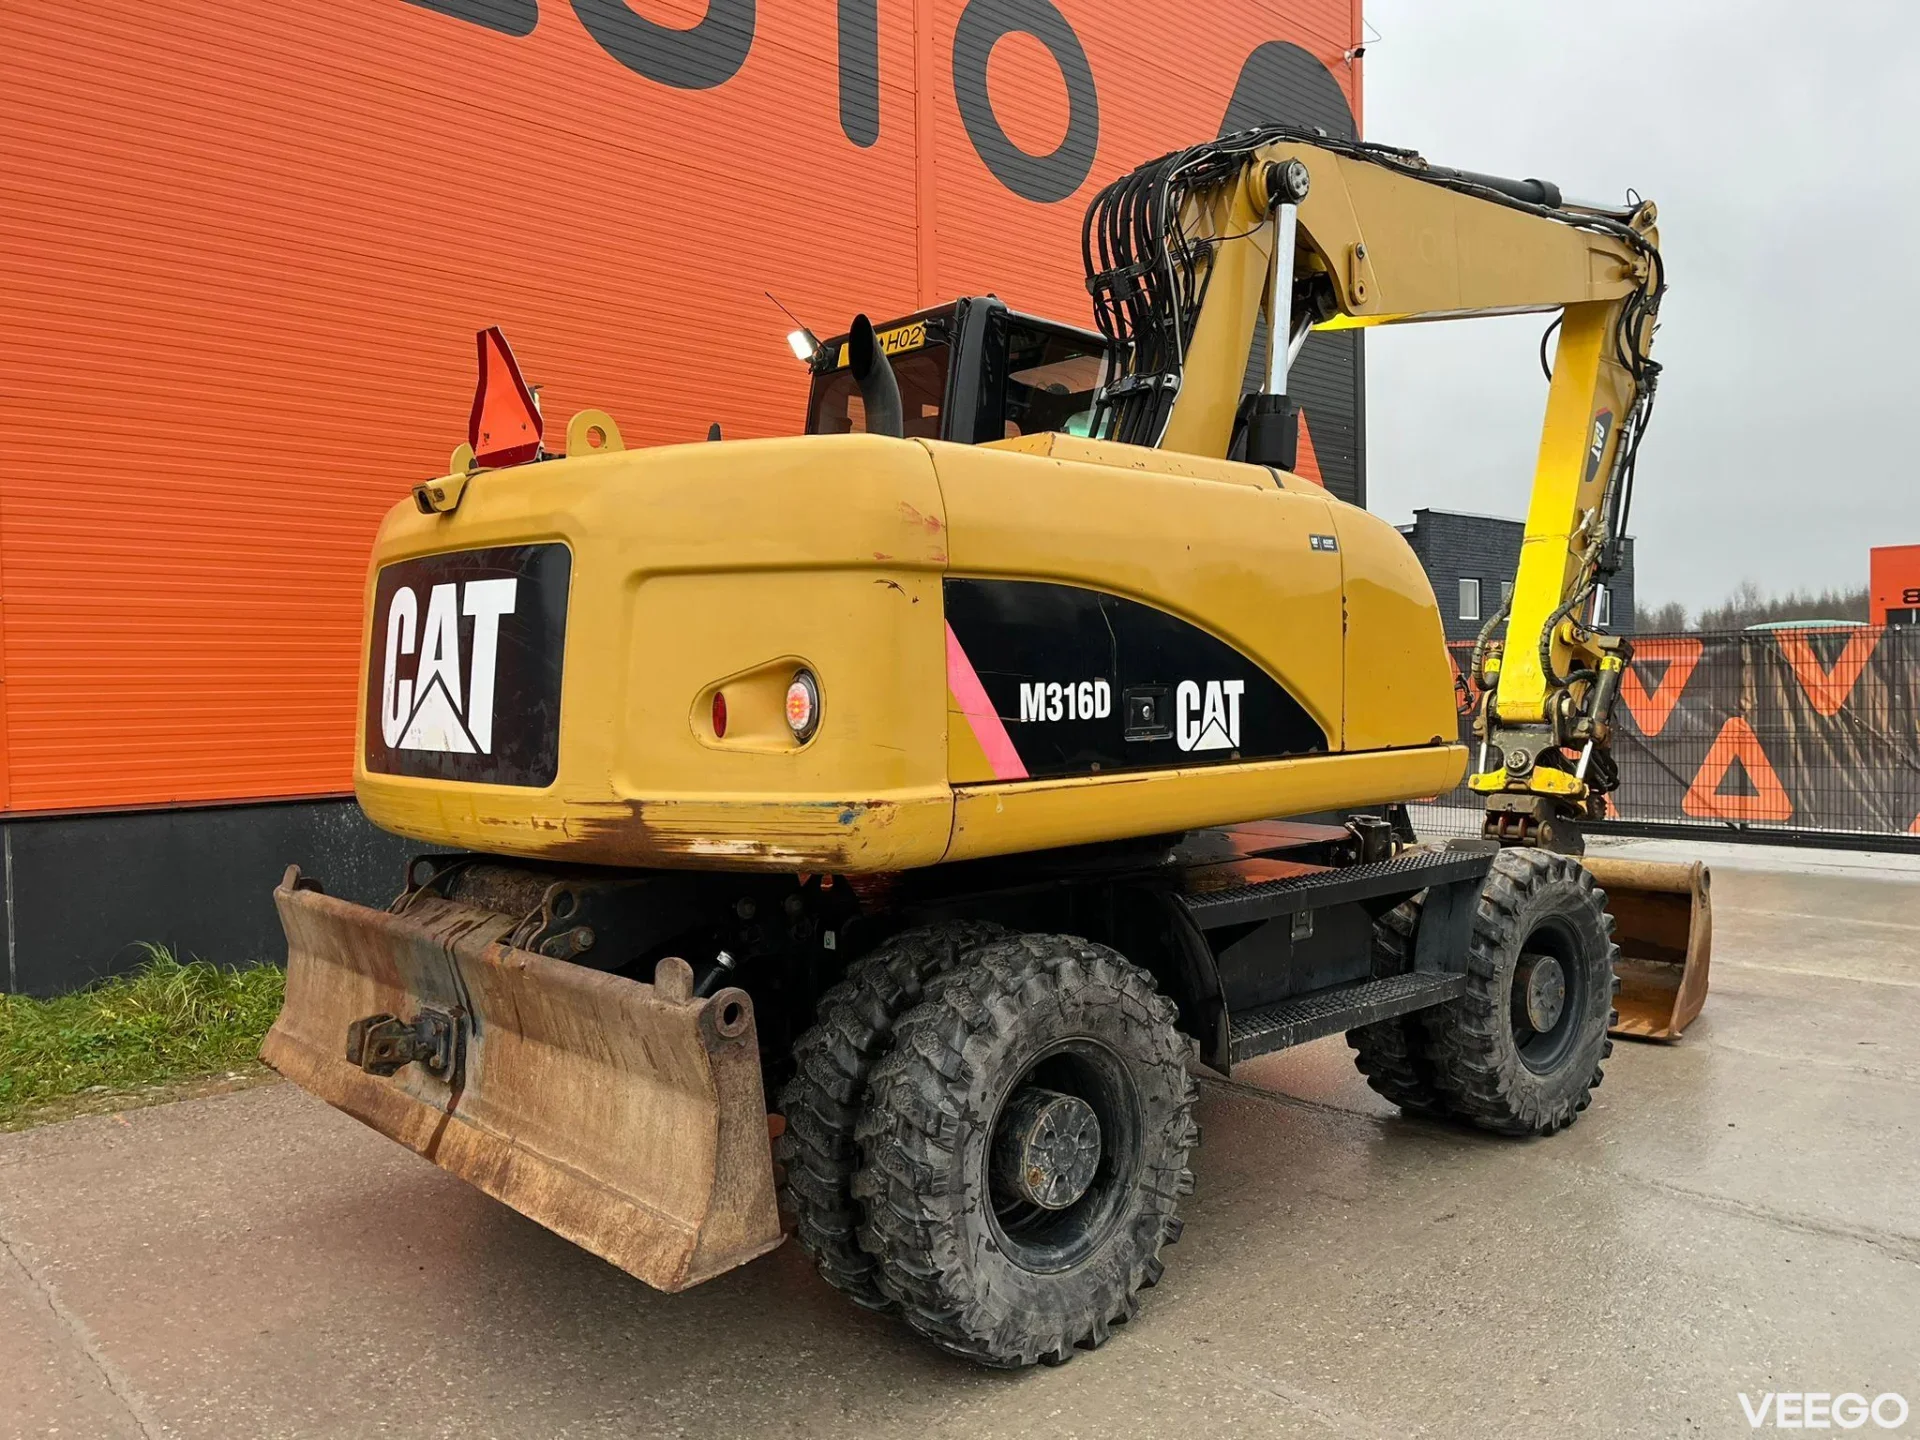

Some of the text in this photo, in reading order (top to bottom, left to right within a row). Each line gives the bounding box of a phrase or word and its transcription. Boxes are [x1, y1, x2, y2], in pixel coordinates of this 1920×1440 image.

[1591, 421, 1605, 462] CAT
[382, 578, 517, 754] CAT
[1020, 680, 1111, 722] M316D
[1176, 680, 1245, 752] CAT
